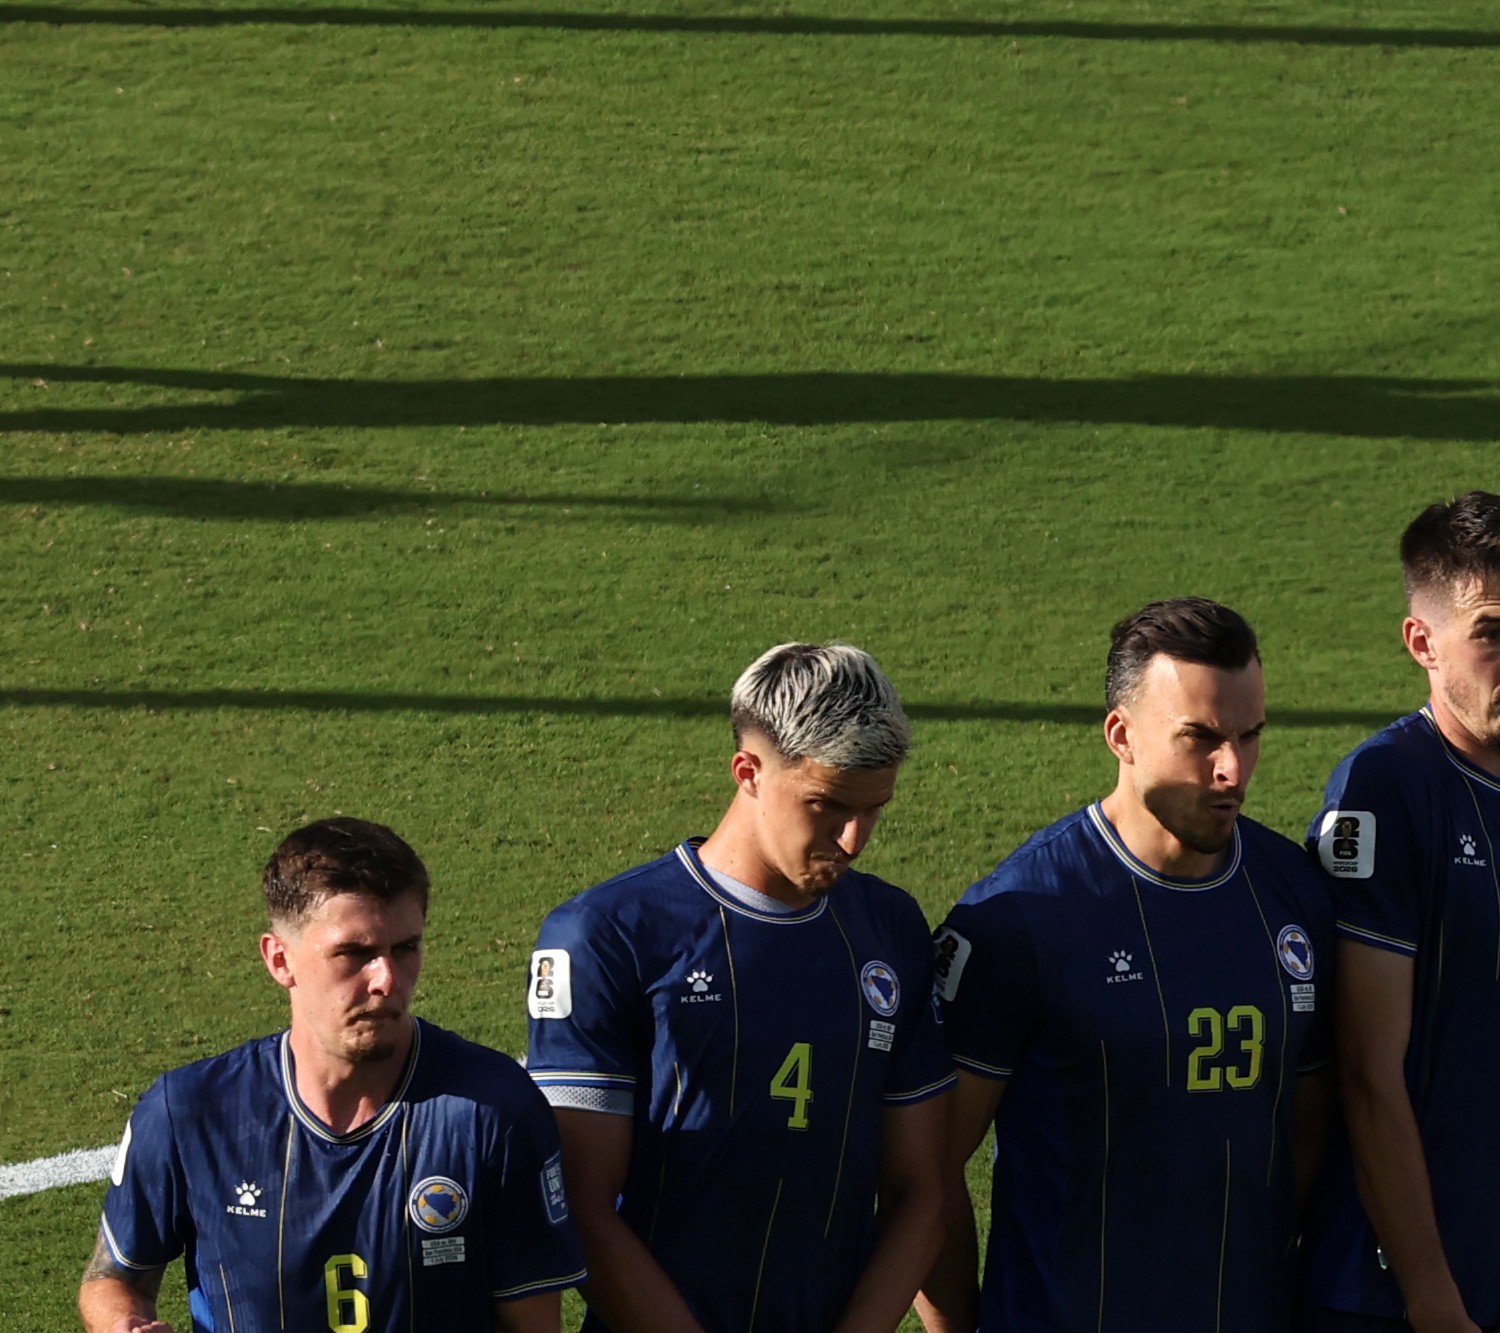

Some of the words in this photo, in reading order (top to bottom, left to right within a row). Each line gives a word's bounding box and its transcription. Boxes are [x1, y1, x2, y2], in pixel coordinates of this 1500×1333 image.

[1454, 857, 1487, 867] KELME
[1106, 972, 1144, 984] KELME
[681, 994, 722, 1004] KELME
[1187, 1005, 1265, 1092] 23
[770, 1042, 814, 1130] 4
[227, 1205, 267, 1218] KELME
